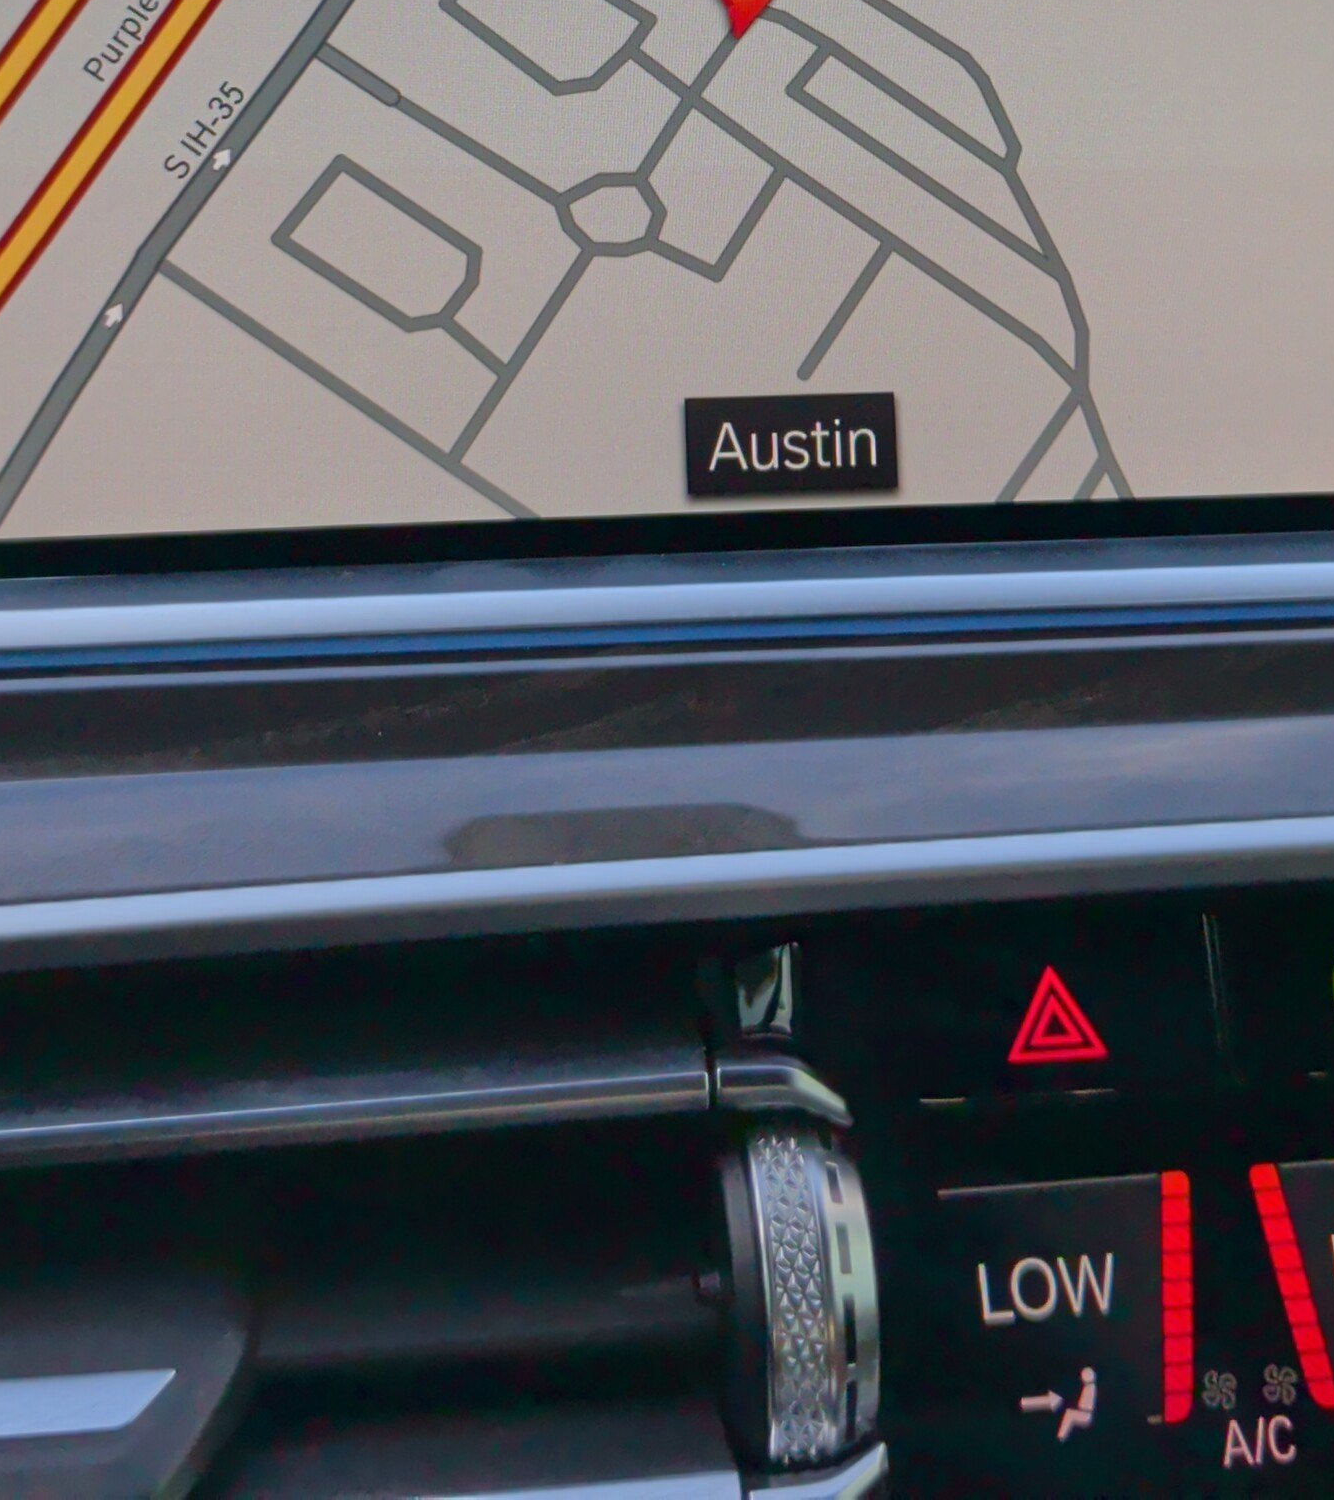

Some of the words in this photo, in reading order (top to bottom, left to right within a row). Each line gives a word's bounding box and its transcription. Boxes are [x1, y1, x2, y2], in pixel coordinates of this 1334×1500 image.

[164, 153, 190, 179] S
[180, 81, 244, 156] IH-35
[708, 418, 877, 472] Austin
[977, 1252, 1115, 1326] LOW
[1223, 1414, 1298, 1469] A/C
